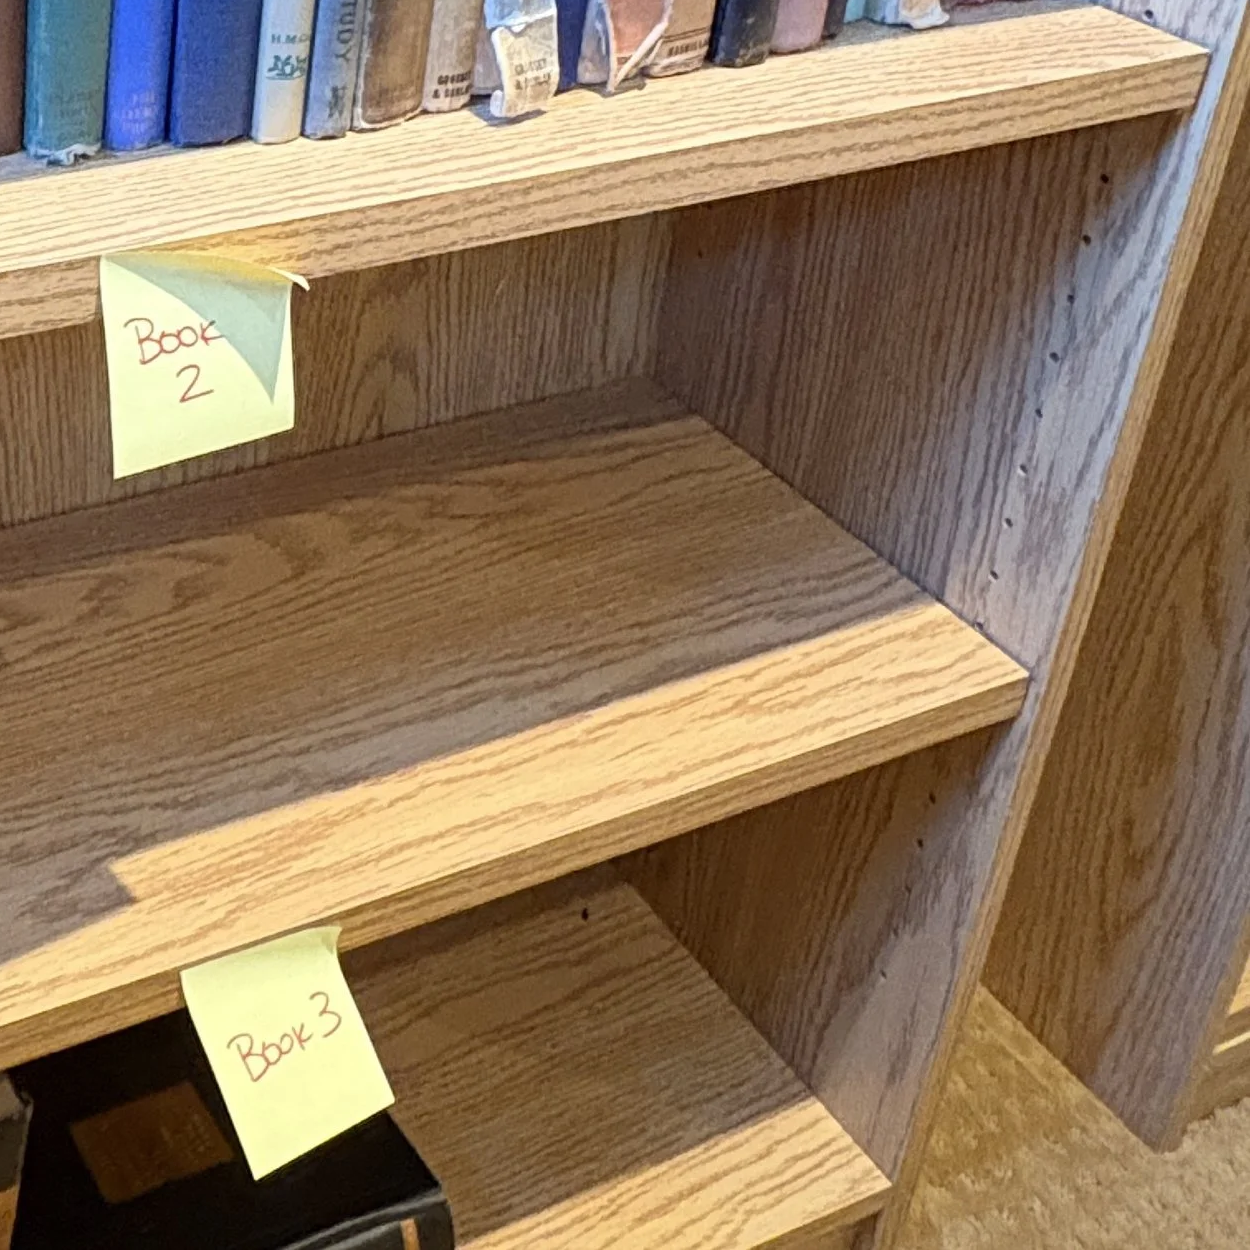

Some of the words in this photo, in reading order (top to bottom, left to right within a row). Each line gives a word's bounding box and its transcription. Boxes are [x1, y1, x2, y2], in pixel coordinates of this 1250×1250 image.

[123, 317, 227, 365] Book
[176, 364, 215, 403] 2
[227, 1021, 315, 1083] Book
[309, 991, 342, 1039] 3
